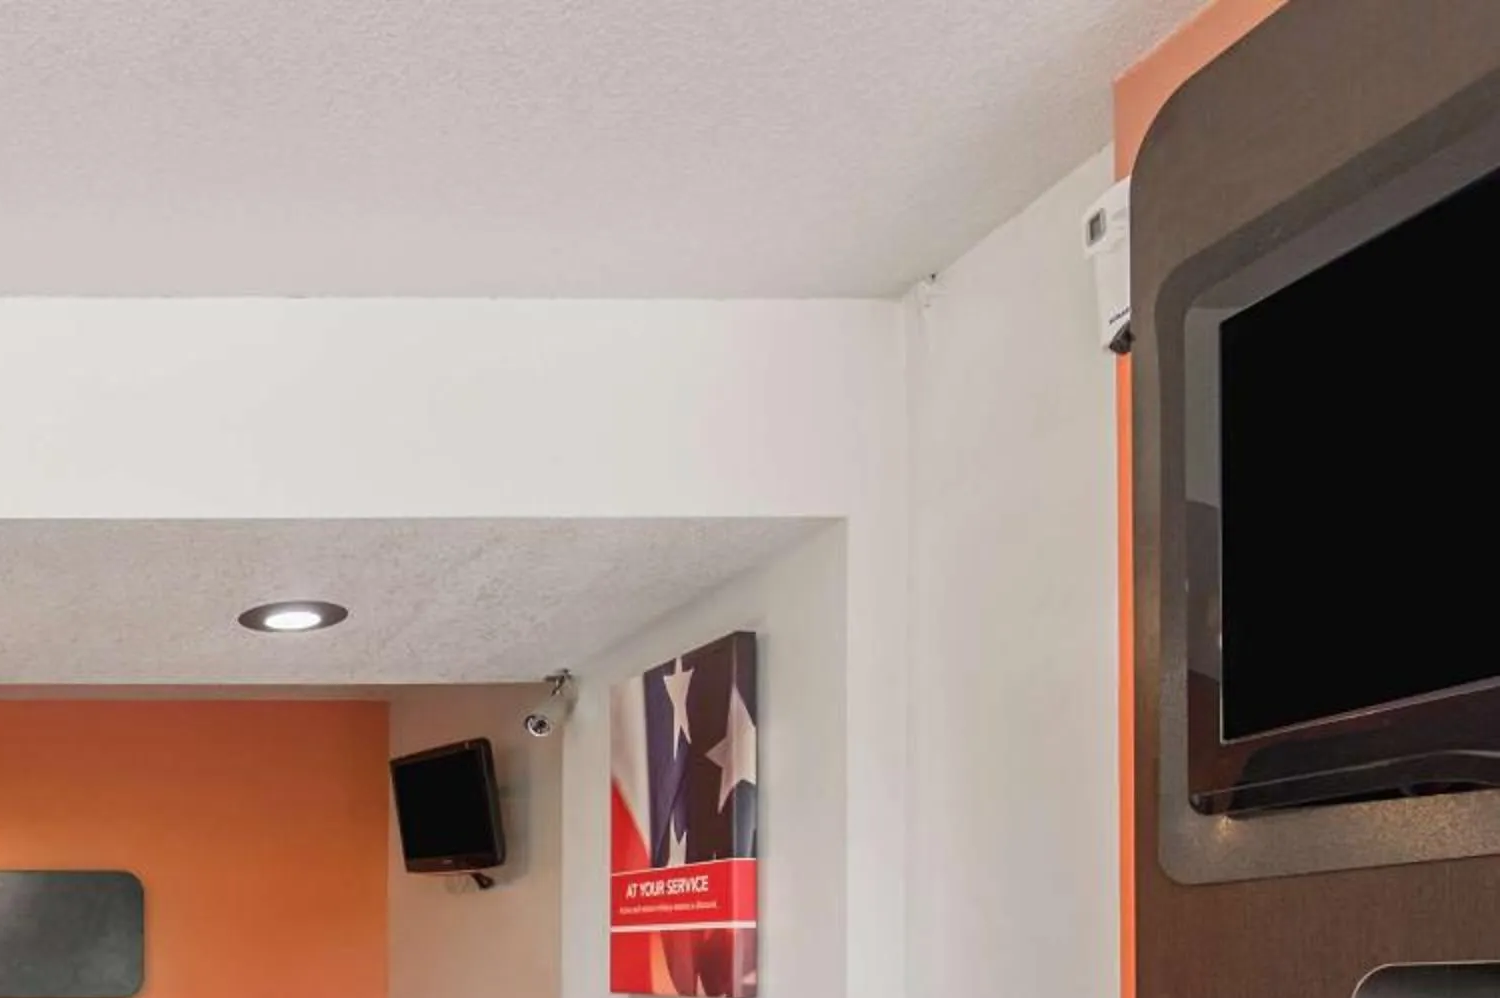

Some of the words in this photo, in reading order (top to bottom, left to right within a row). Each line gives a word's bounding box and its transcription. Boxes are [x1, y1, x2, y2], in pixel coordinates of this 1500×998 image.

[625, 883, 638, 899] AT
[640, 880, 665, 897] YOUR
[666, 875, 709, 895] SERVICE
